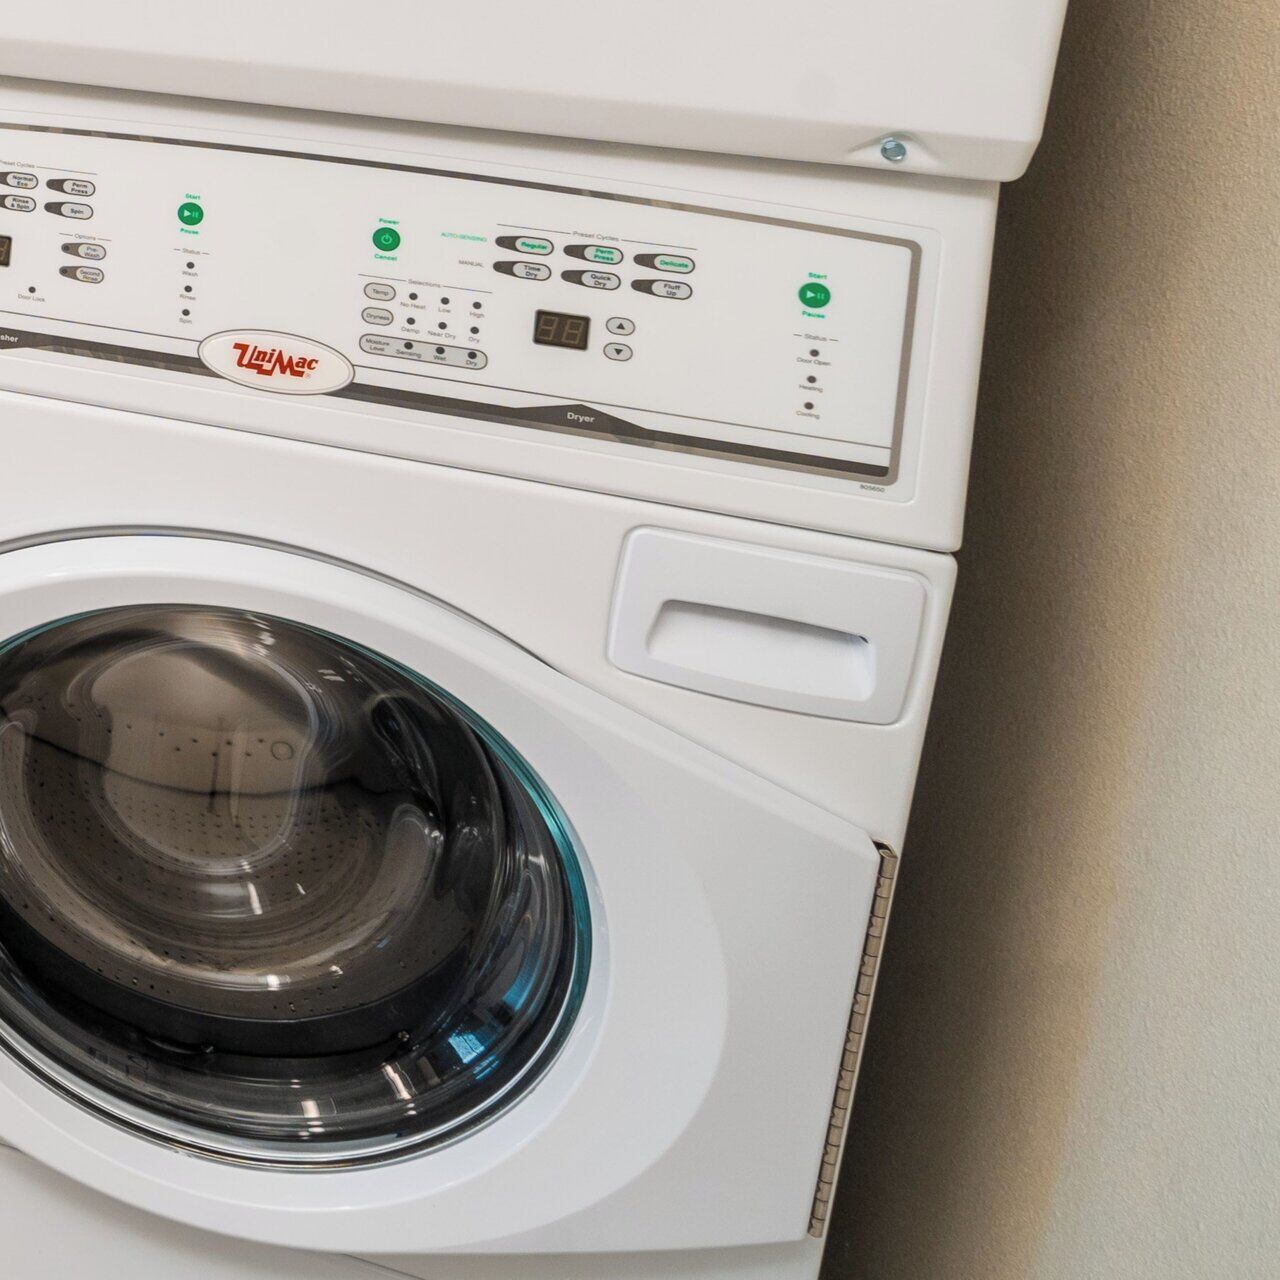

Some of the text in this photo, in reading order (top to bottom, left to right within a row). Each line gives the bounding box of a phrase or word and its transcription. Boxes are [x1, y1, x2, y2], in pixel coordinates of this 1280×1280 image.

[573, 231, 619, 242] Preset Cycles
[521, 241, 547, 251] Regular
[594, 254, 614, 262] Press
[660, 260, 689, 269] Delicate
[591, 274, 611, 282] Quick
[408, 279, 441, 288] Selections
[594, 280, 607, 288] Dry
[664, 283, 680, 291] Fluff
[667, 289, 677, 297] Up
[366, 313, 389, 321] Dryness
[802, 311, 825, 319] Pause
[401, 326, 420, 334] Damp
[233, 342, 319, 378] UniMac
[567, 412, 595, 423] Dryer
